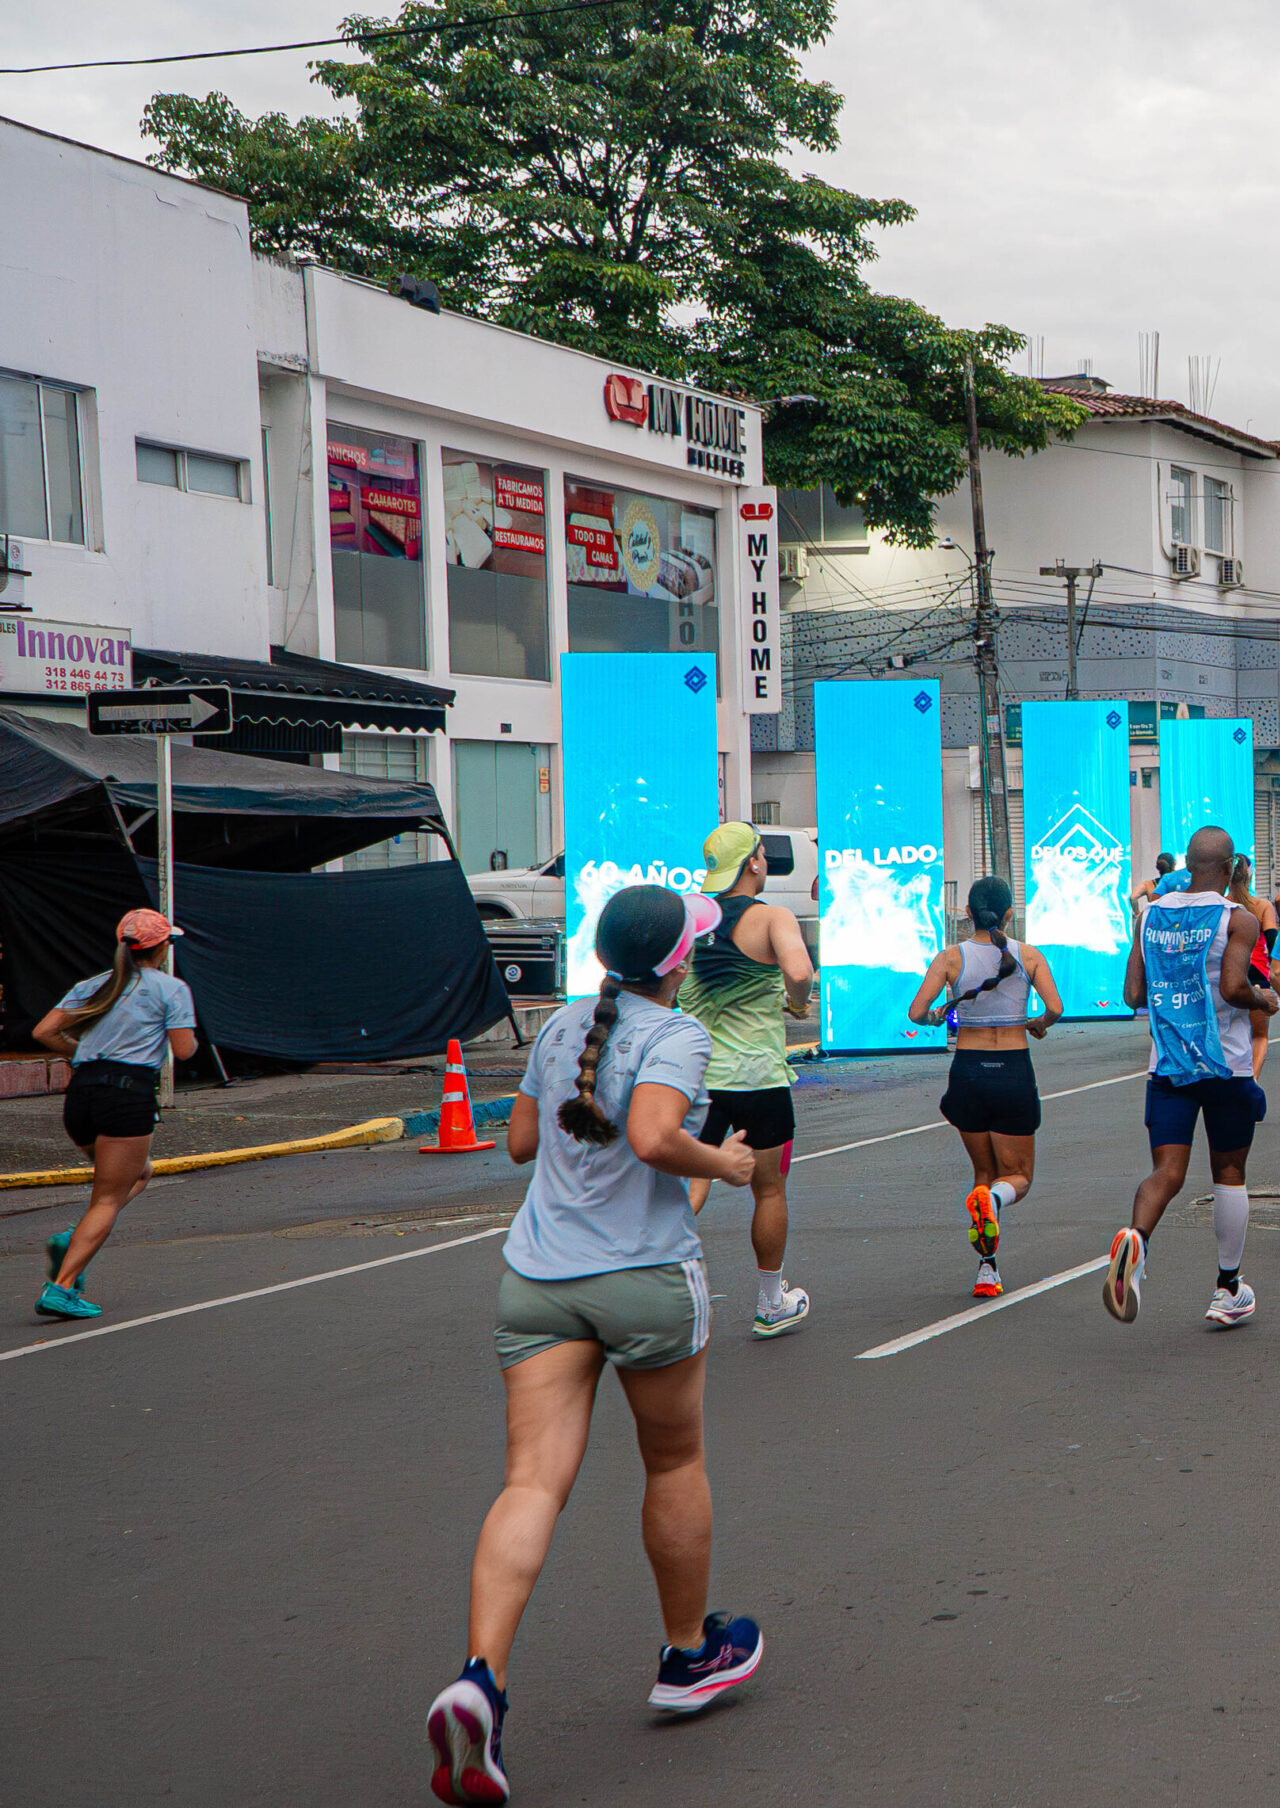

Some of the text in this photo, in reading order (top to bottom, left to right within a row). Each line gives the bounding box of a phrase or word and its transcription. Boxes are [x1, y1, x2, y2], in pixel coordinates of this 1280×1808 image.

[648, 384, 746, 453] MY HOME
[498, 477, 543, 498] FABRICAMOS
[368, 492, 417, 513] CAMAROTES
[498, 494, 543, 512] A TU MEDIDA
[495, 530, 544, 550] RESTAURAMOS
[574, 528, 606, 545] TODO EN
[591, 551, 613, 565] CAMAS
[747, 533, 768, 583] MY
[17, 620, 130, 666] Innovar
[750, 591, 771, 699] HOME
[45, 667, 124, 682] 318 446 44 73
[45, 679, 67, 690] 312
[70, 681, 91, 692] 865
[873, 844, 937, 865] LADO
[580, 860, 708, 891] 60 AÑOS
